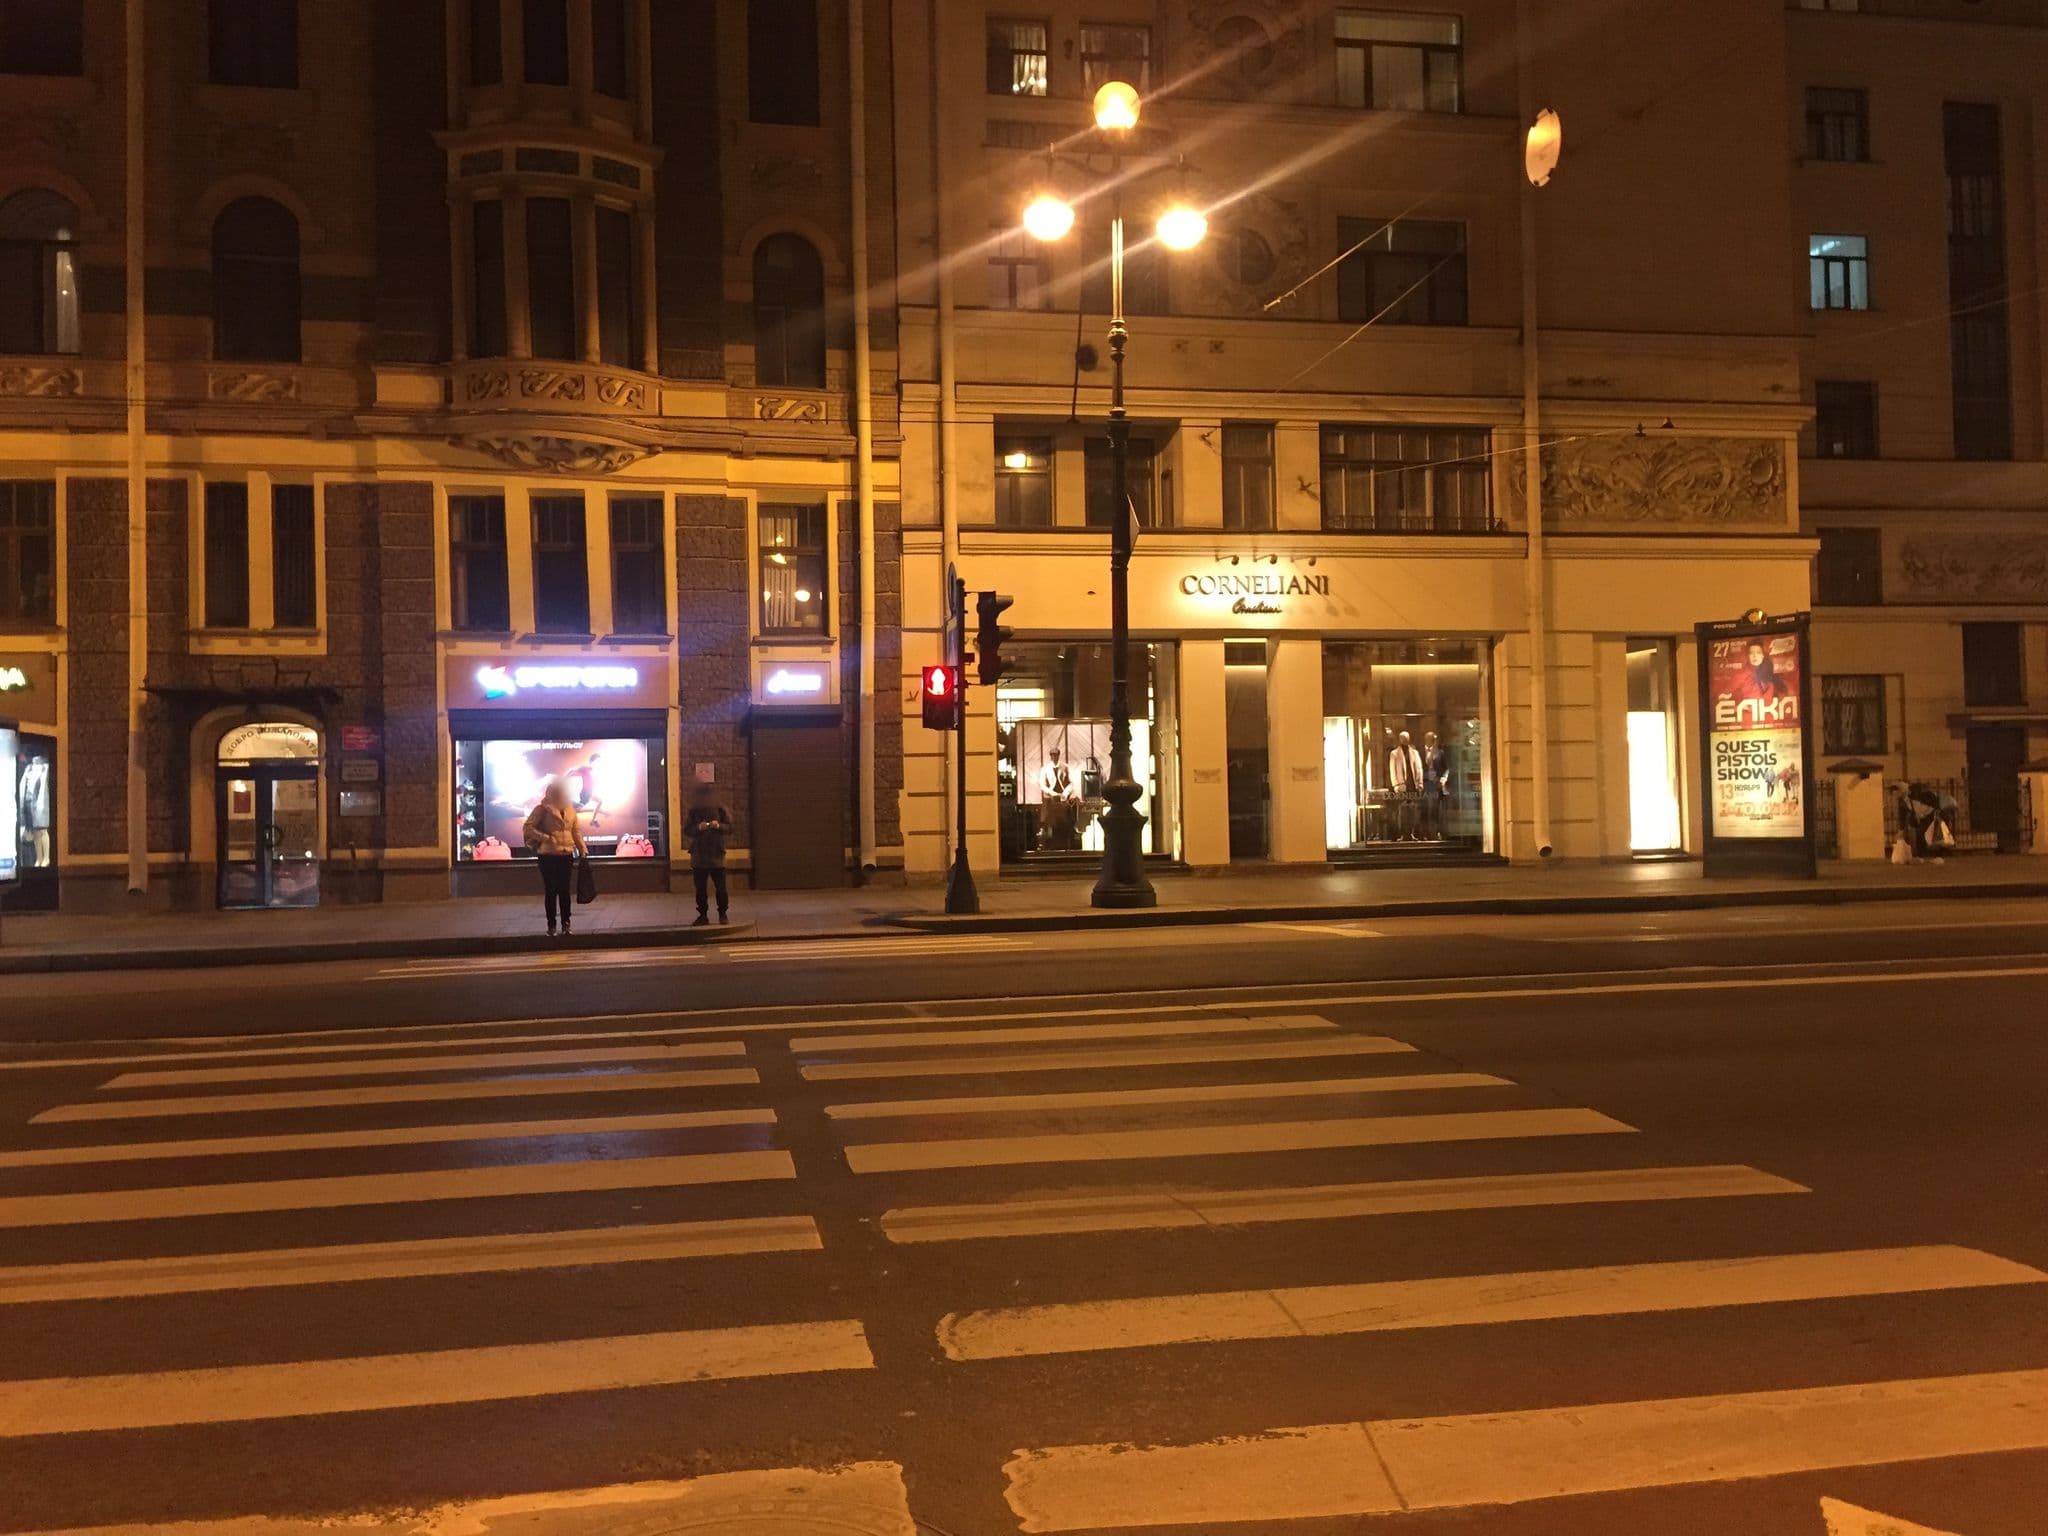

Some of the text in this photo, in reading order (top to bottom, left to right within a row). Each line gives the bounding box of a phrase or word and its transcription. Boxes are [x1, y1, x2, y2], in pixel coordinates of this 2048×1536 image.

[1180, 574, 1329, 596] CORNELIANI
[1713, 641, 1730, 658] 27
[1716, 739, 1771, 754] QUEST
[1717, 753, 1778, 767] PISTOLS
[1717, 767, 1769, 780] SHOW
[1719, 783, 1734, 800] 13
